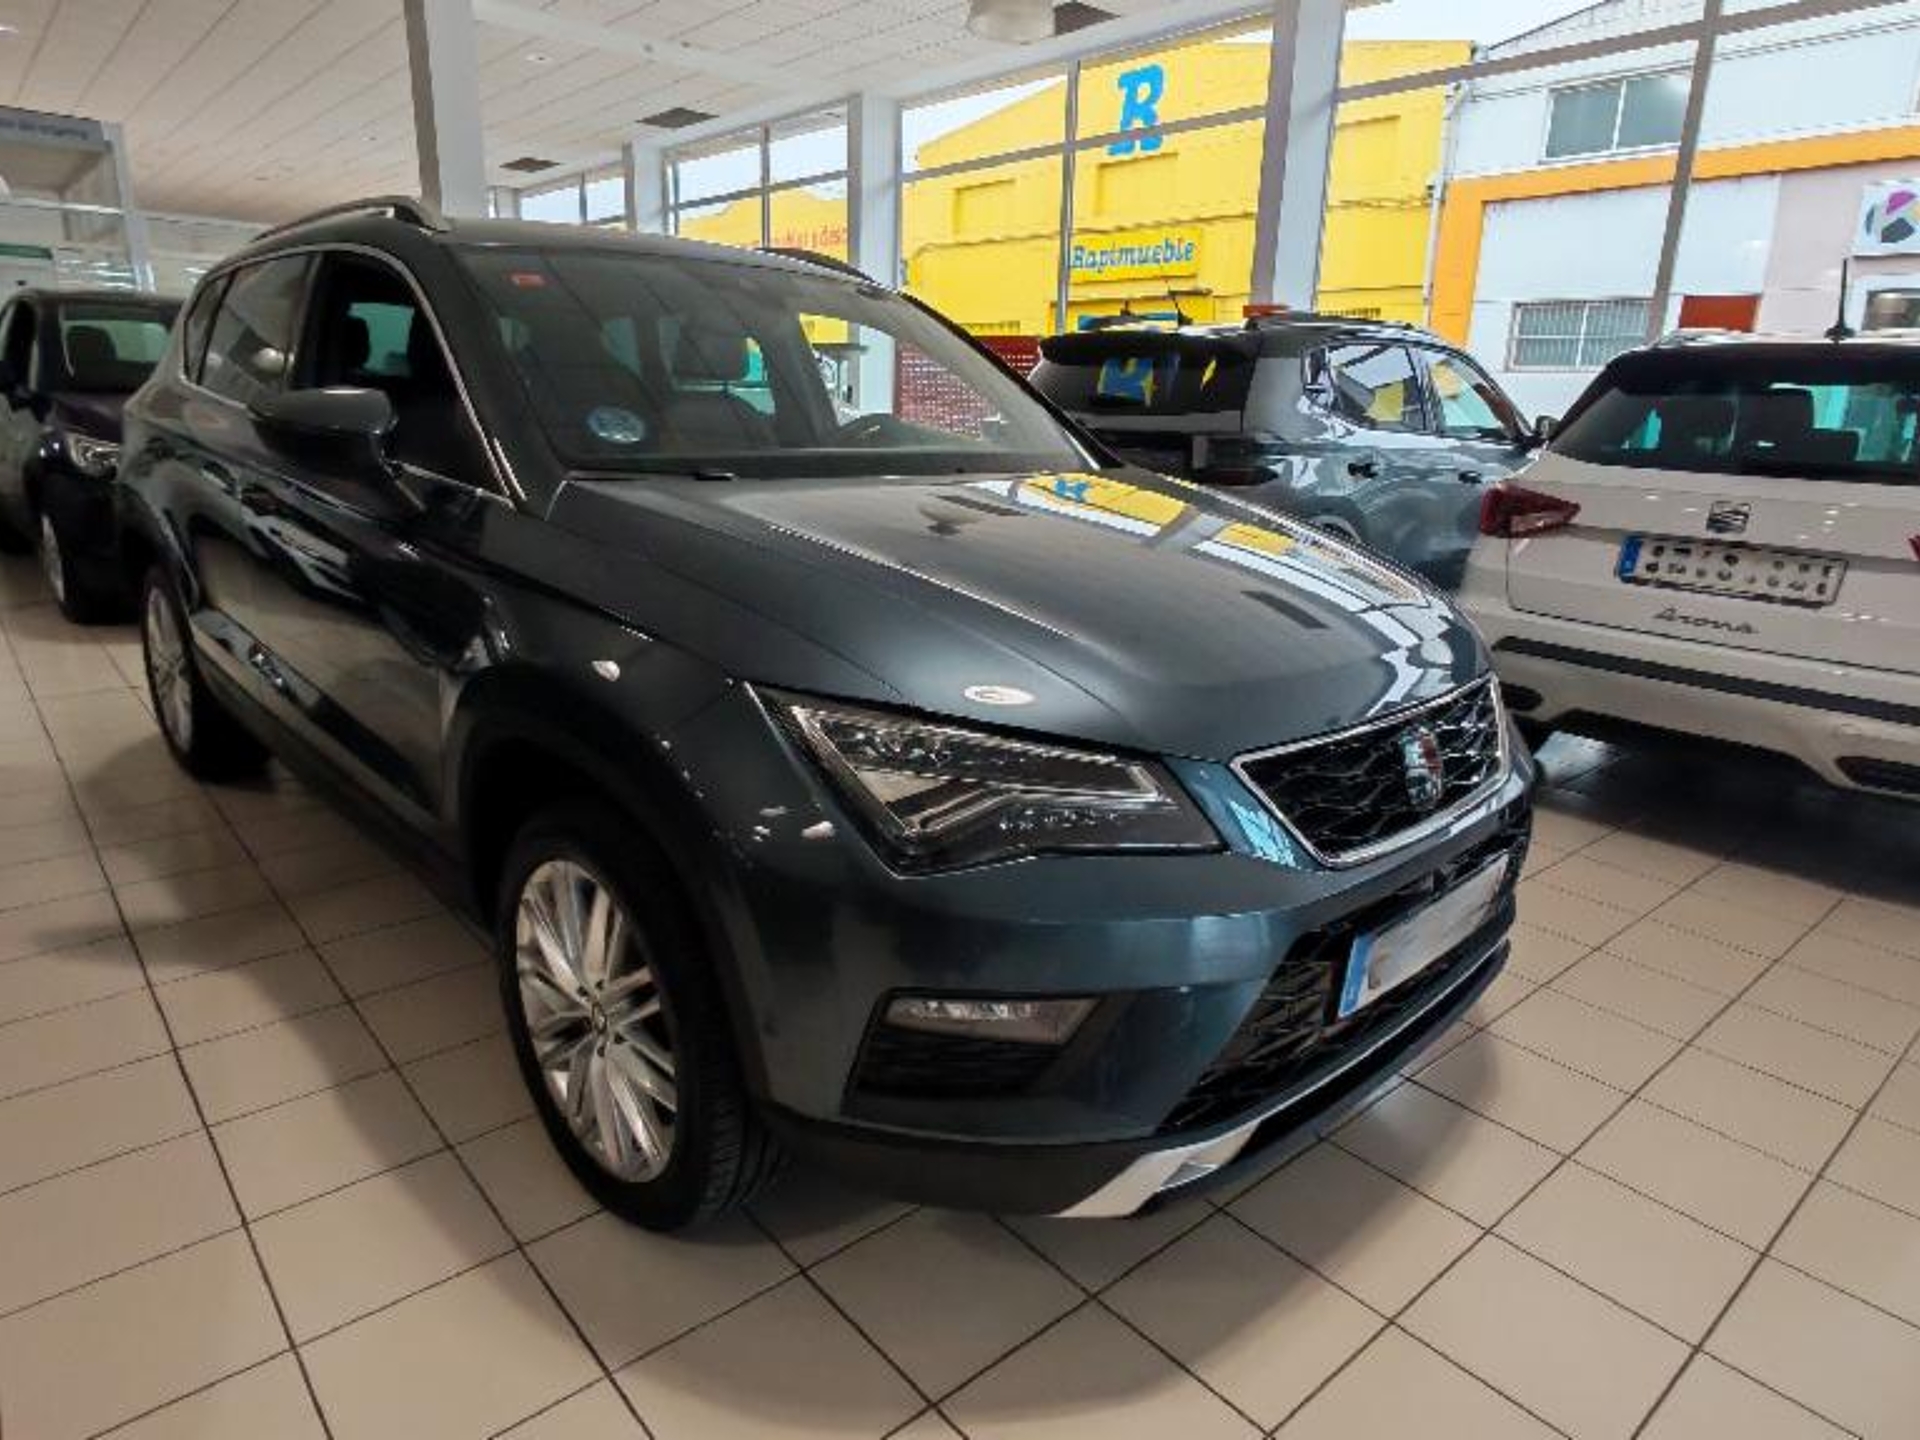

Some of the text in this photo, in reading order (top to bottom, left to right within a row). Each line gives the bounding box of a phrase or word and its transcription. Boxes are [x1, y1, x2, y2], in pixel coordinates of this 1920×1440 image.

[1107, 64, 1163, 154] R
[1072, 238, 1194, 272] Rapimueble
[1654, 606, 1758, 634] Arona
